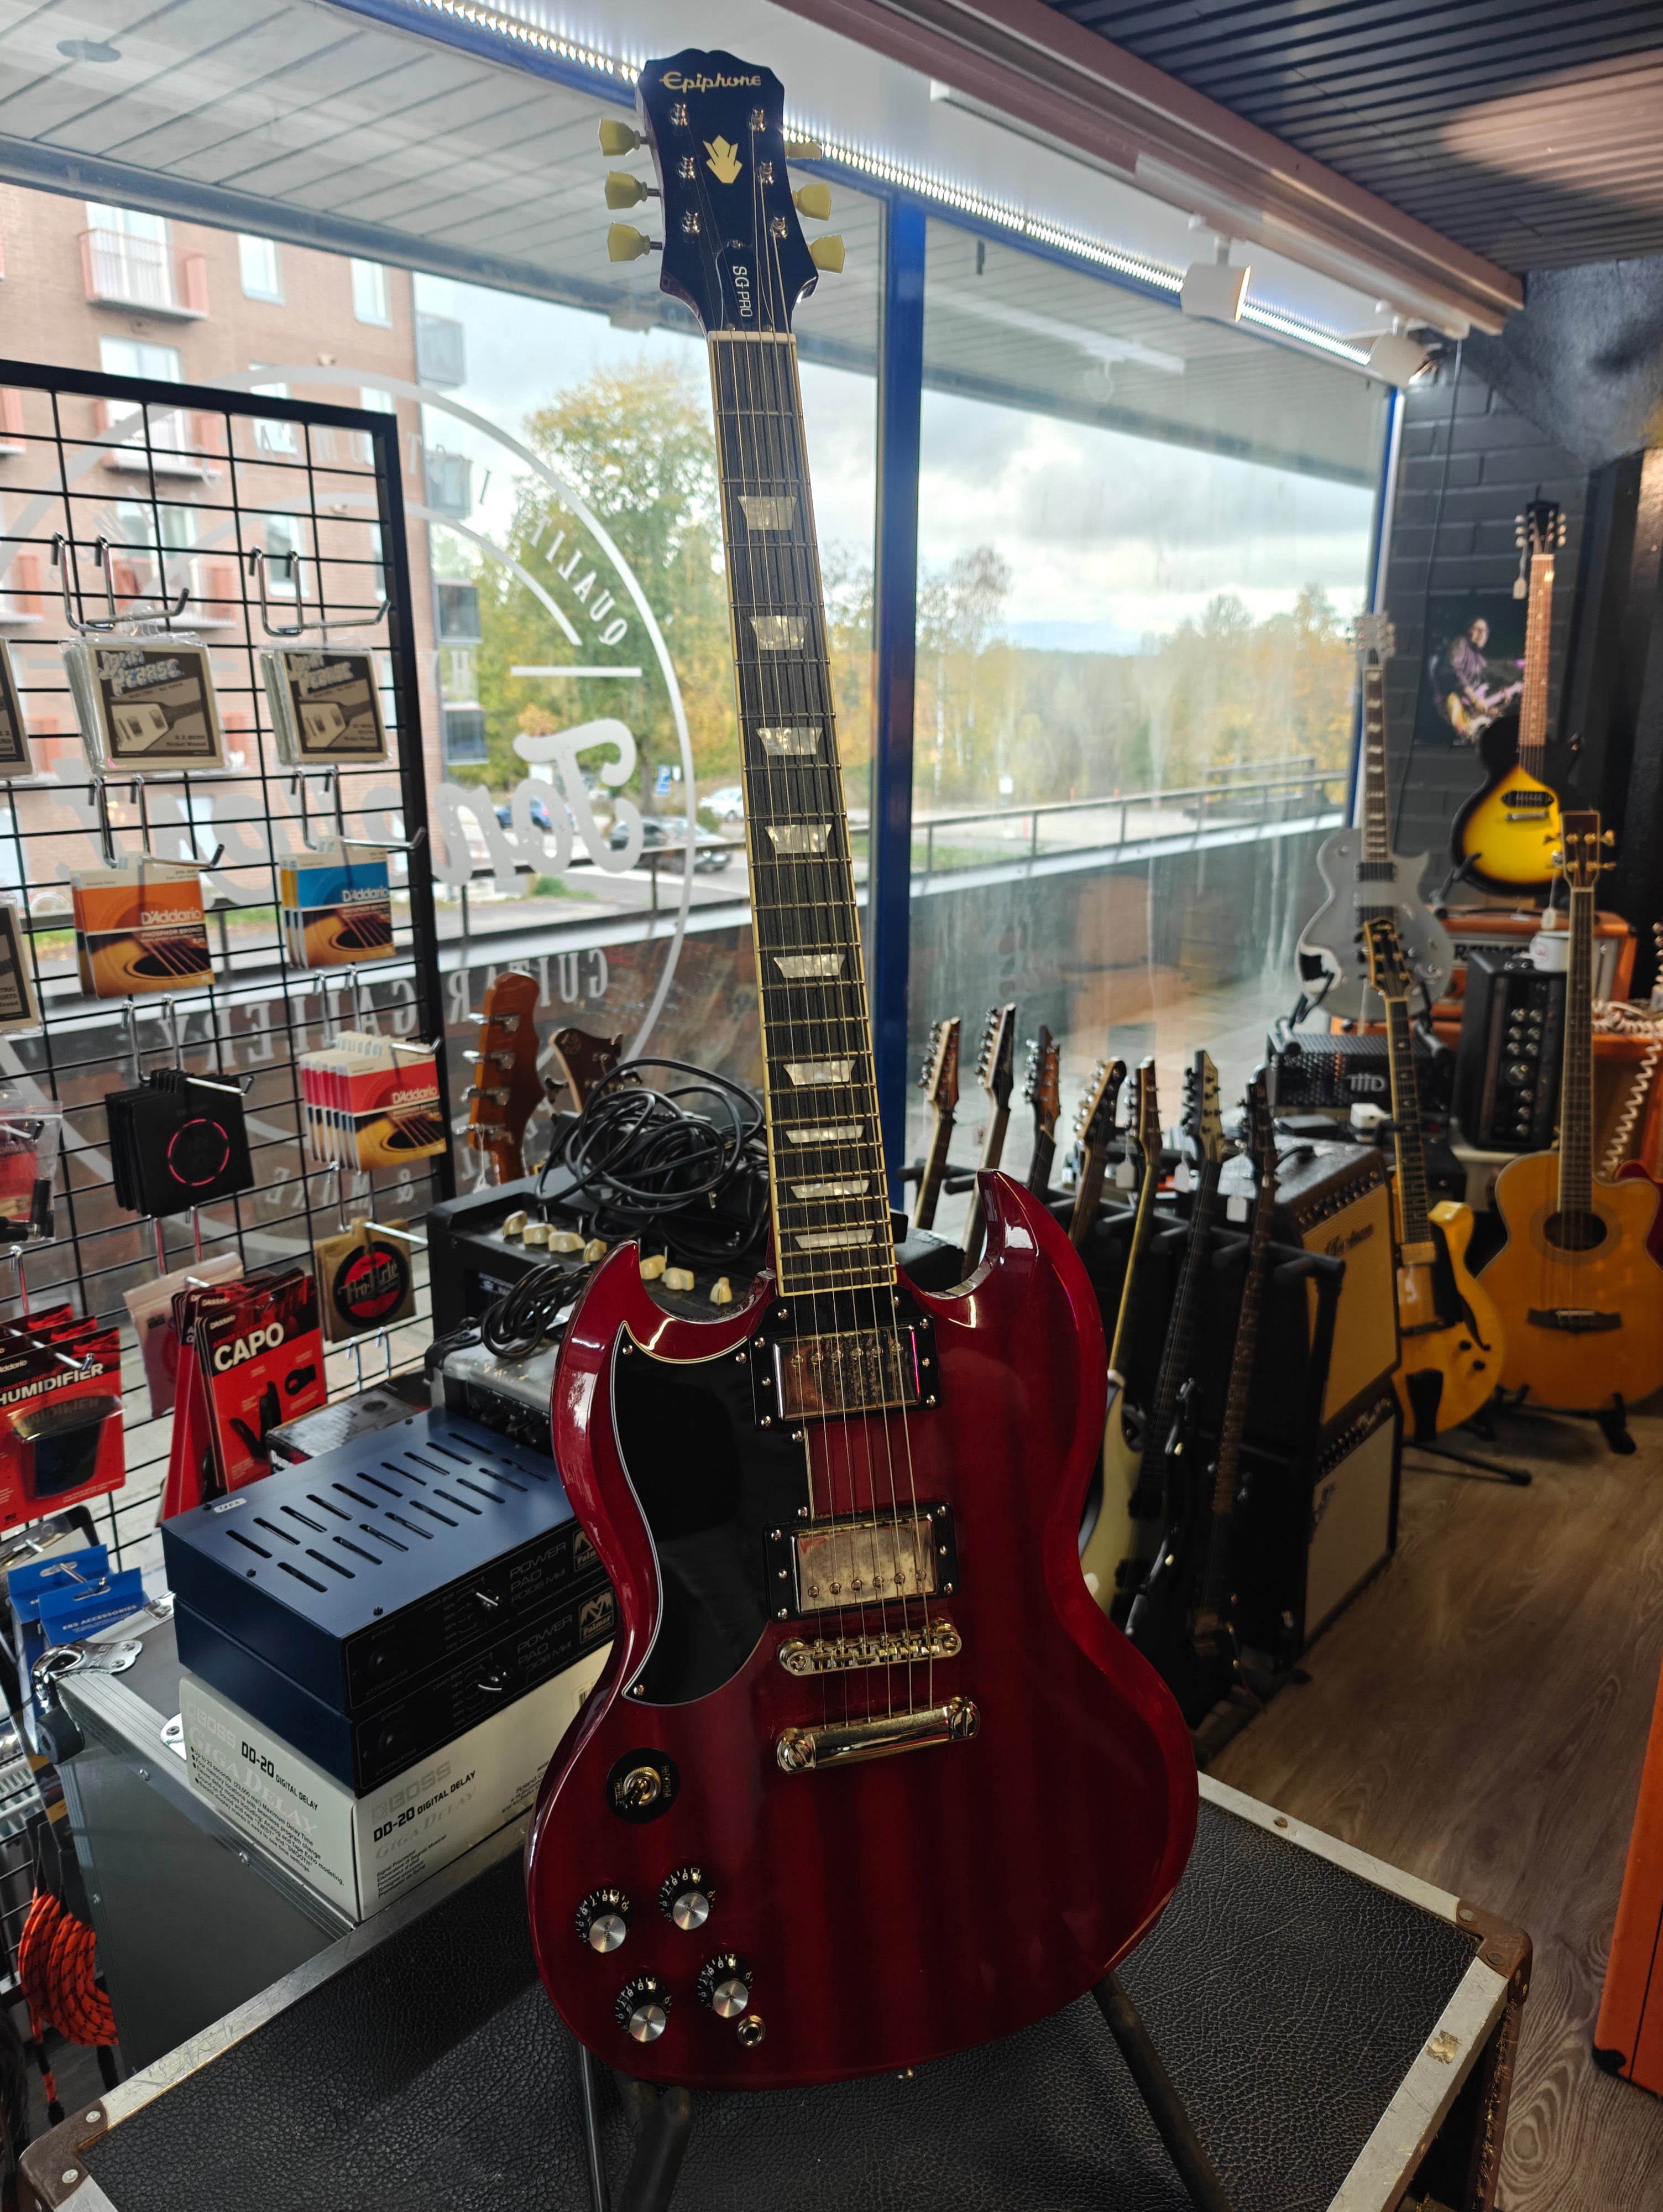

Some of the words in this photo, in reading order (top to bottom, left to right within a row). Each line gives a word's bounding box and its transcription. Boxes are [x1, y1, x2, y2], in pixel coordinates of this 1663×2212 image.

[659, 71, 761, 93] Epiphone
[733, 266, 750, 289] SG
[737, 291, 753, 317] PRO
[141, 907, 202, 925] D'Addario
[392, 1086, 437, 1104] D'Addario
[214, 1322, 285, 1371] CAPO
[510, 1541, 567, 1579] POWER
[577, 1551, 598, 1564] Palm
[510, 1569, 541, 1593] PAD
[517, 1615, 573, 1654] POWER
[583, 1615, 611, 1634] Palmer
[518, 1642, 548, 1666] PAD
[197, 1713, 236, 1750] BOSS
[189, 1726, 239, 1781] GIGA
[244, 1767, 318, 1834] DELAY
[242, 1741, 274, 1778] DD-20
[276, 1775, 297, 1798] DIGITAL
[299, 1791, 318, 1811] DELAY
[389, 1761, 451, 1811] BOSS
[374, 1807, 415, 1842] DD-20
[417, 1790, 448, 1815] DIGITAL
[451, 1770, 475, 1793] DELAY
[261, 1801, 286, 1826] Maximum
[286, 1820, 300, 1838] Delay
[280, 1824, 301, 1847] program
[301, 1840, 321, 1863] change
[376, 1827, 420, 1859] GIGA
[304, 1849, 318, 1866] Echo
[376, 1864, 391, 1877] Signal
[393, 1849, 416, 1867] Processor
[602, 1893, 608, 1902] 8
[683, 1901, 699, 1919] VOLUME
[707, 1966, 715, 1976] 8
[718, 1960, 724, 1969] 9
[626, 1989, 634, 1998] 8
[637, 1983, 644, 1991] 9
[724, 1992, 736, 2003] TONE
[641, 2015, 654, 2027] TONE
